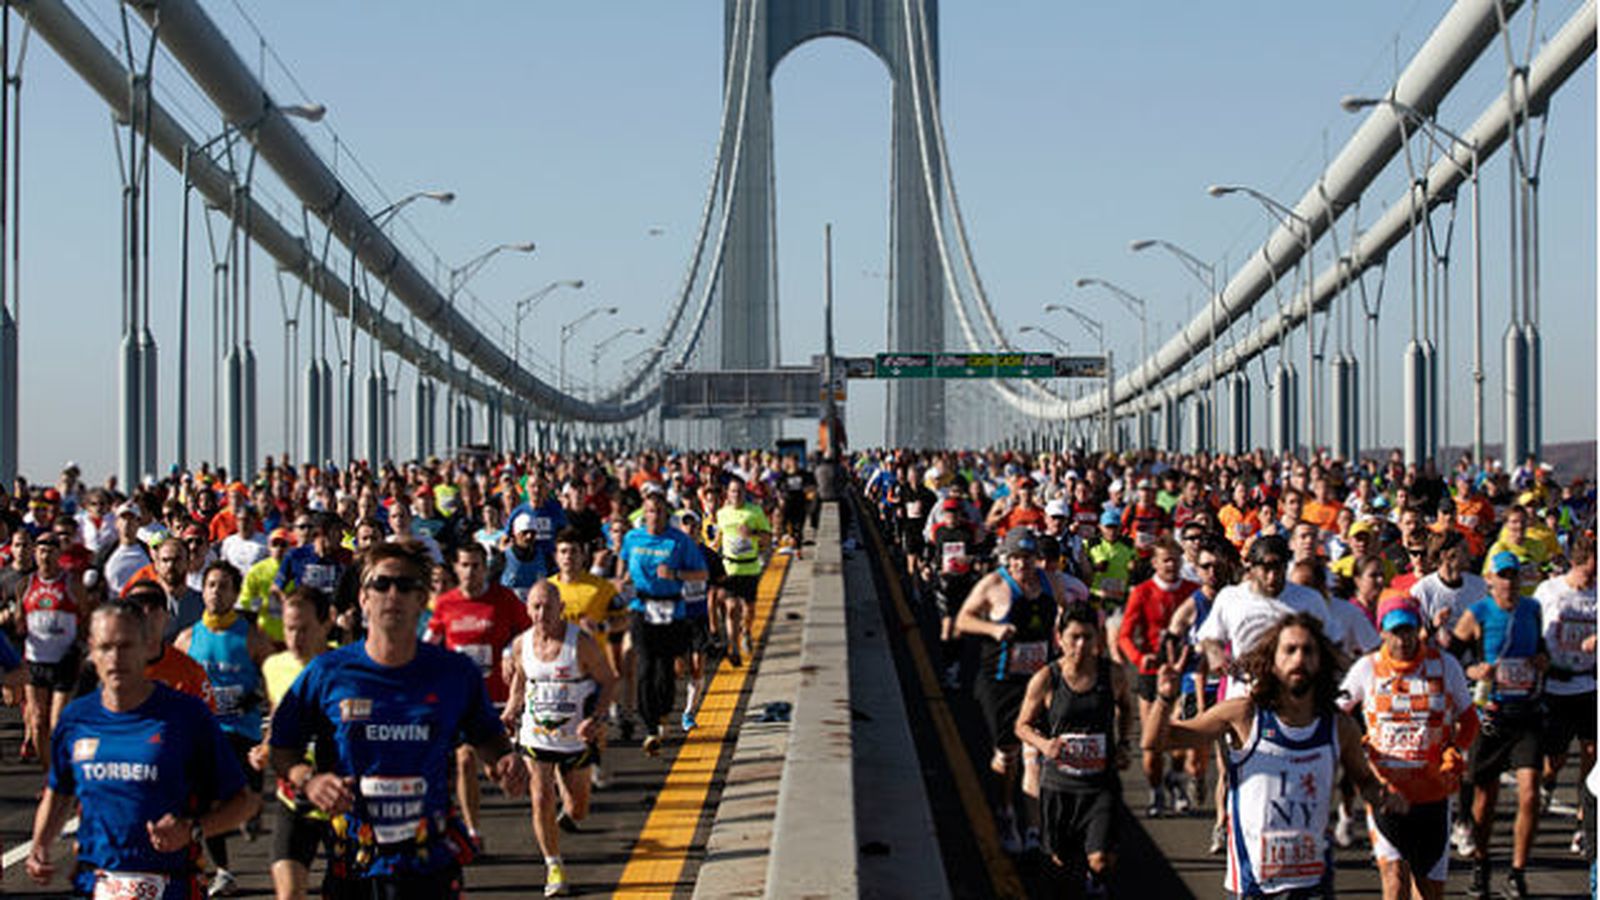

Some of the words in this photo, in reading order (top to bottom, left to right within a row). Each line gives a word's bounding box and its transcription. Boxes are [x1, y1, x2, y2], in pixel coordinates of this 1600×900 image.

[365, 724, 430, 741] EDWIN
[82, 762, 159, 781] TORBEN
[1279, 771, 1288, 798] I
[1269, 800, 1319, 828] NY
